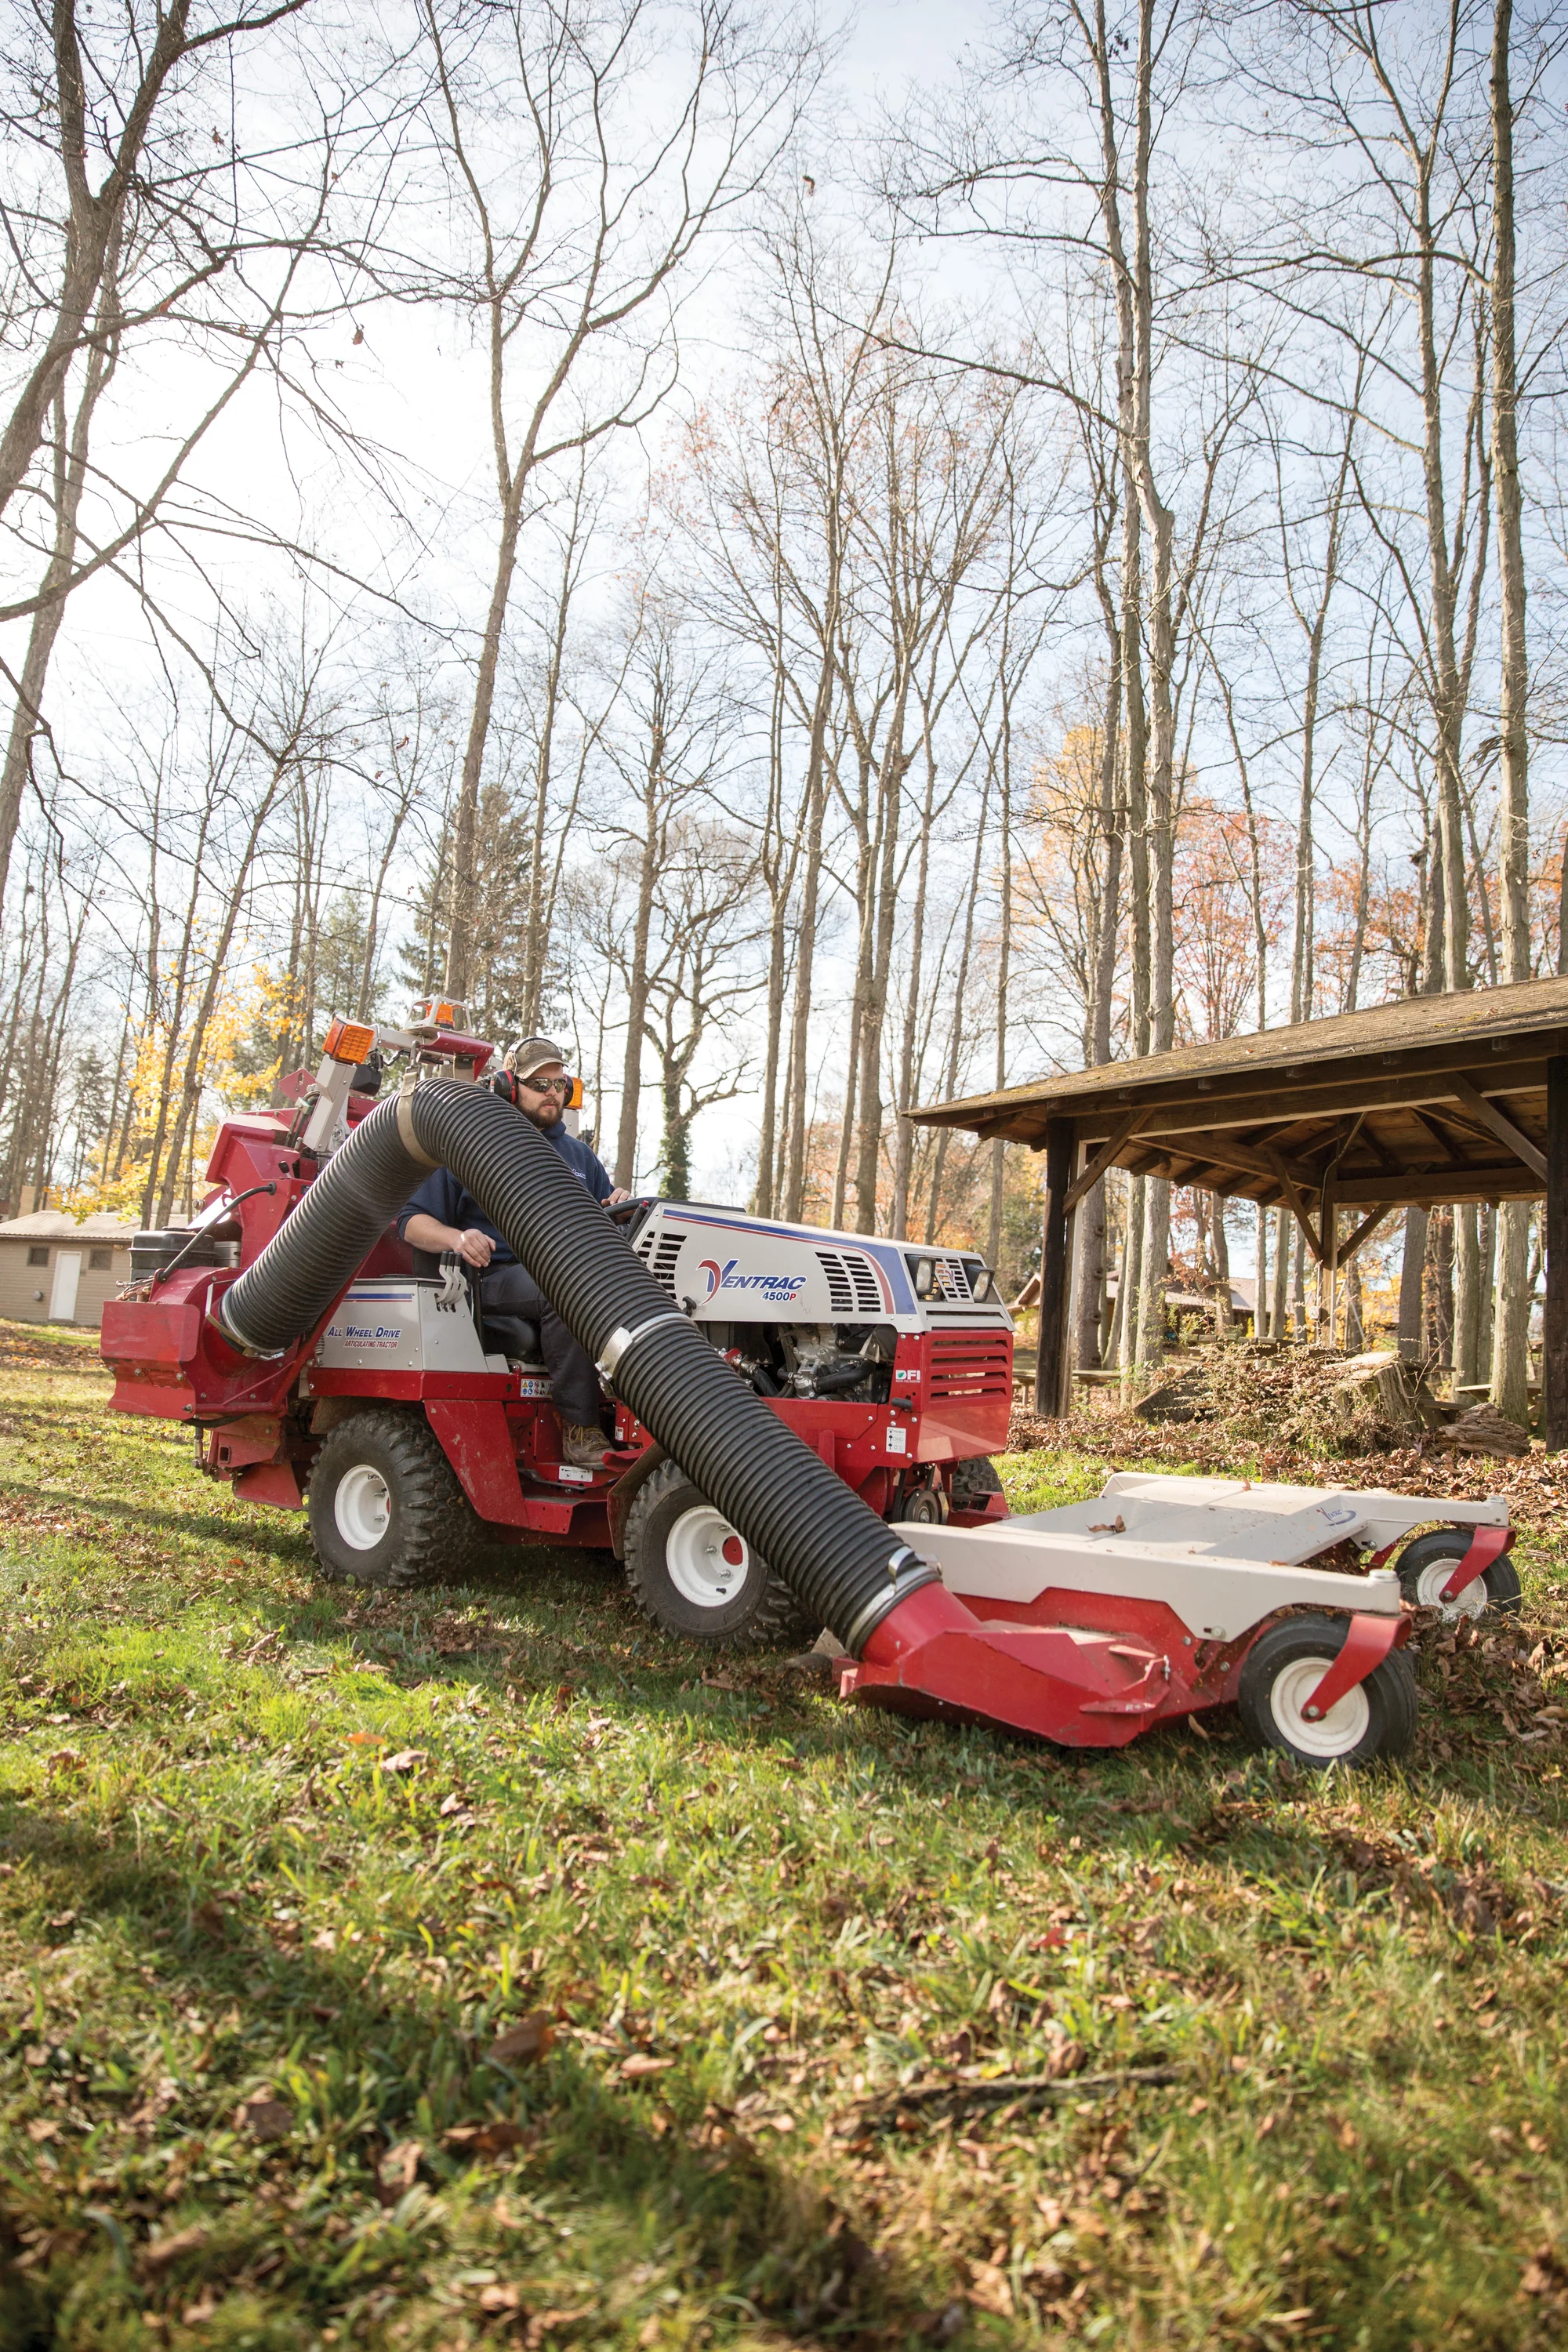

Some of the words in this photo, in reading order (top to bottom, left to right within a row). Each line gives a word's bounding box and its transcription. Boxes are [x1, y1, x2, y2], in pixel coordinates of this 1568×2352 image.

[696, 1259, 807, 1305] VENTRAC
[762, 1292, 797, 1301] 4500P
[327, 1326, 342, 1337] ALL
[346, 1326, 372, 1338] WHEEL
[376, 1327, 401, 1338] DRIVE
[895, 1370, 920, 1380] DFI
